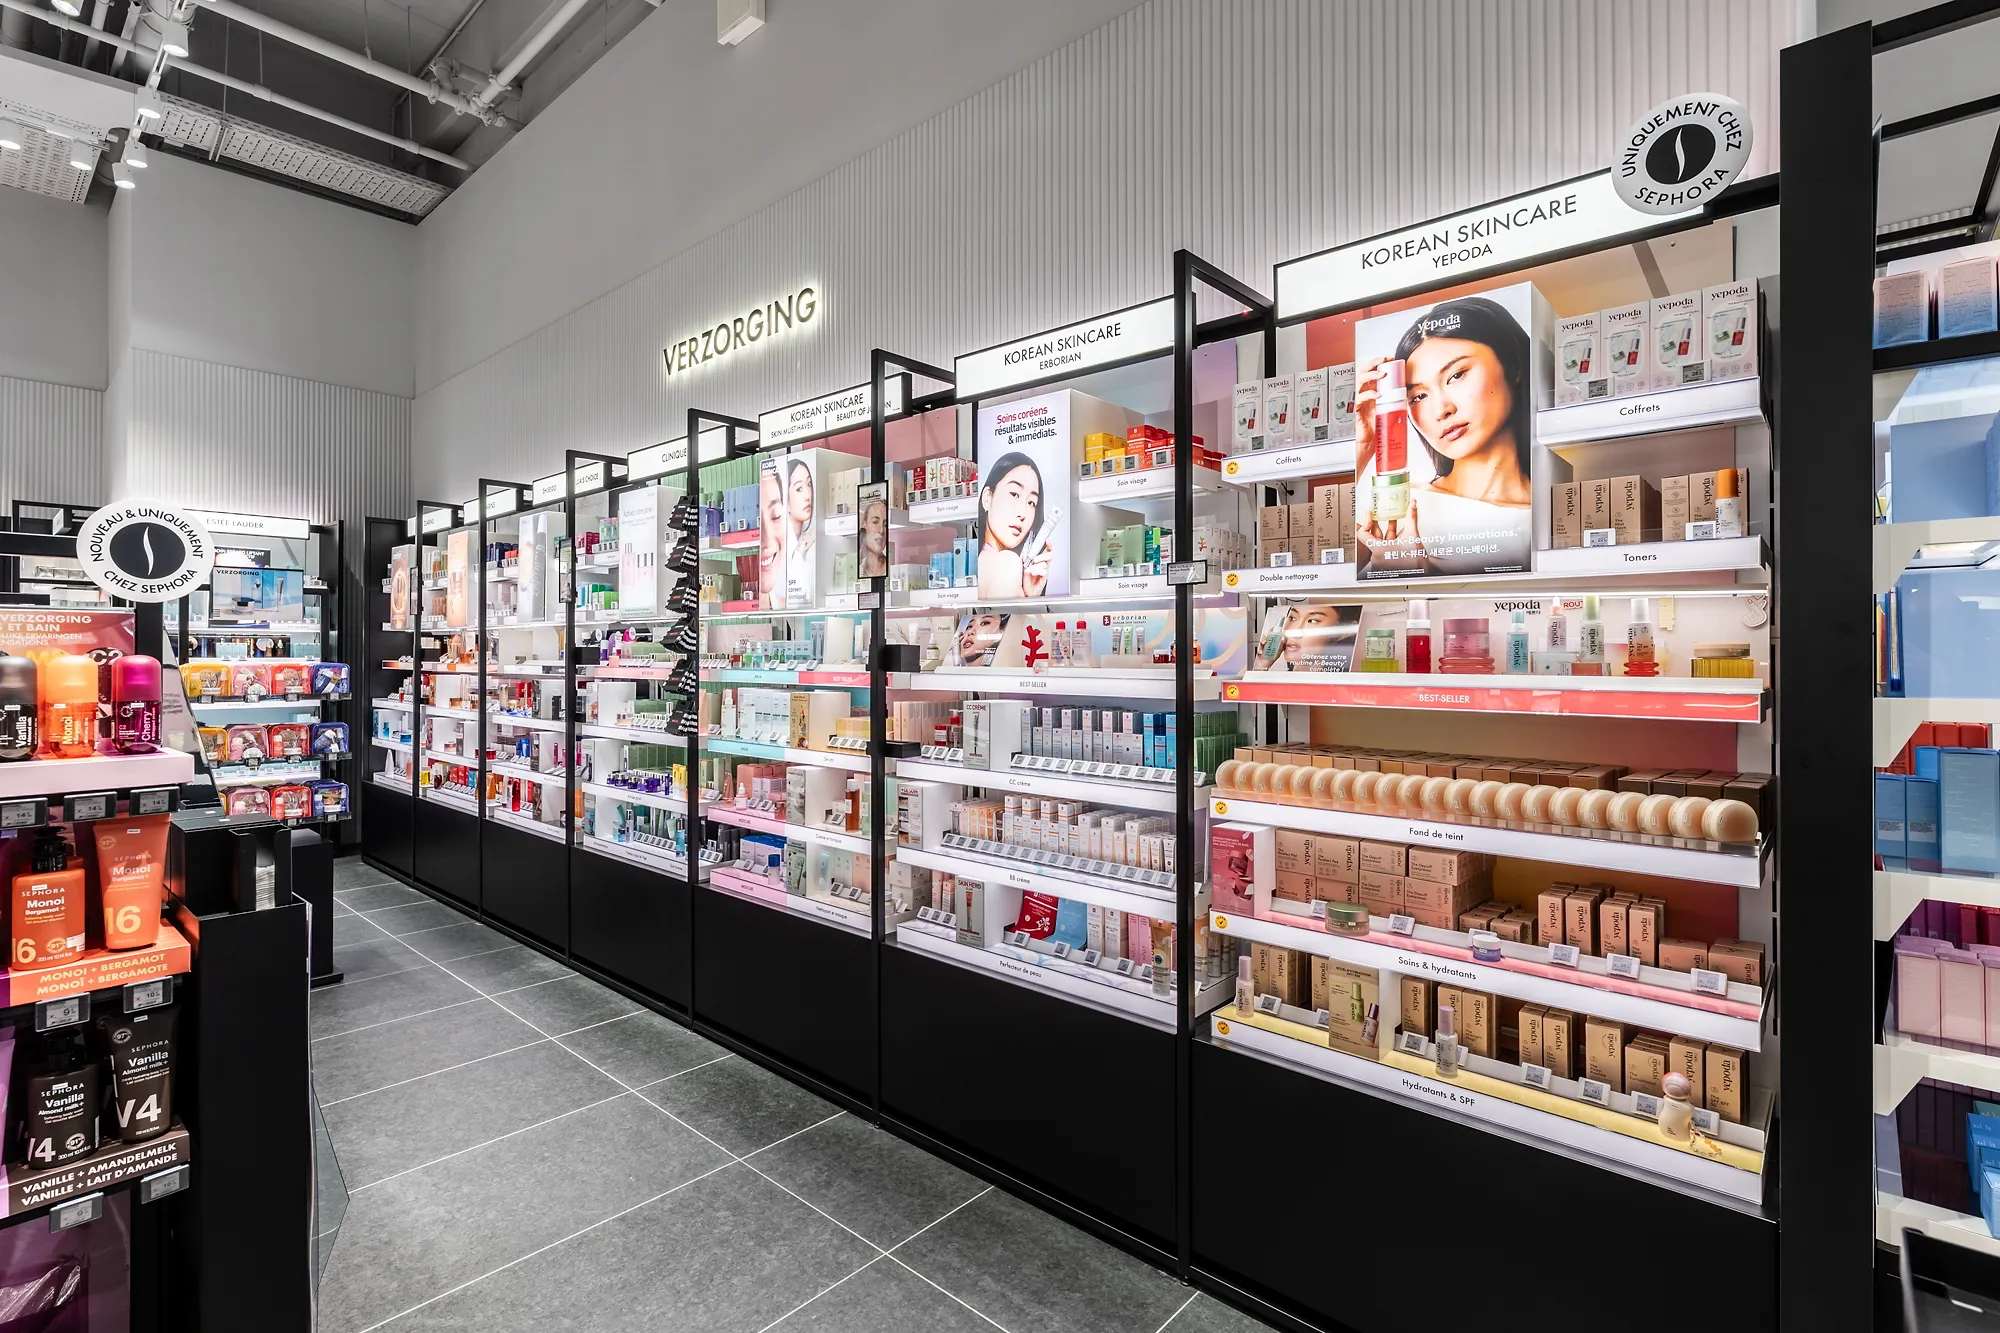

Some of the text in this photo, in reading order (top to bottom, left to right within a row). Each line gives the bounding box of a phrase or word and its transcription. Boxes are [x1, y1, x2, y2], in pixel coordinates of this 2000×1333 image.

[1622, 101, 1742, 178] UNIQUEMENT CHEZ
[1635, 167, 1729, 206] SEPHORA
[1362, 195, 1577, 269] KOREAN SKINCARE
[1432, 244, 1492, 268] YEPODA
[1711, 285, 1748, 300] yepoda
[1658, 298, 1693, 312] yepoda
[1417, 314, 1460, 333] yepoda
[1608, 309, 1642, 322] yepoda
[662, 287, 817, 376] VERZORGING
[1561, 319, 1593, 332] yepoda
[1004, 322, 1121, 366] KOREAN SKINCARE
[1039, 352, 1082, 371] ERBORIAN
[790, 405, 822, 423] KOREAN
[823, 393, 864, 414] SKINCARE
[836, 410, 857, 422] BEAUTY
[857, 407, 866, 416] OF
[996, 406, 1048, 424] Soins coréens
[1620, 404, 1661, 415] Coffrets
[770, 421, 813, 439] SKIN MUST-HAVES
[994, 416, 1057, 436] résultats visibles
[1008, 428, 1057, 444] & immédiats.
[661, 447, 687, 463] CLINIQUE
[1275, 456, 1302, 465] Coffrets
[1129, 477, 1147, 485] visage
[1594, 484, 1604, 514] yepoda
[1625, 481, 1635, 511] yepoda
[1704, 477, 1713, 506] yepoda
[1566, 487, 1575, 517] yepoda
[232, 520, 264, 529] LAUDER
[90, 508, 203, 562] NOUVEAU & UNIQUEMENT
[1366, 538, 1395, 547] Clean
[1397, 534, 1446, 546] K-Beauty
[1429, 547, 1453, 557] 새로운
[1623, 553, 1657, 562] Toners
[104, 568, 198, 594] CHEZ SEPHORA
[1285, 573, 1318, 581] nettoyage
[1494, 600, 1541, 613] yepoda
[8, 624, 60, 632] ET BAIN
[1551, 621, 1559, 647] yepoda
[1419, 694, 1470, 703] BEST-SELLER
[16, 716, 27, 748] Vanilla
[62, 716, 73, 744] Monoi
[142, 711, 152, 742] Cherry
[1409, 828, 1464, 841] Fond de teint
[114, 854, 152, 862] SEPHORA
[112, 864, 152, 876] Monoi
[112, 874, 144, 882] Bergamot
[22, 887, 65, 897] SEPHORA
[25, 907, 60, 915] Bergamot
[27, 897, 65, 909] Monoi
[40, 968, 88, 983] MONOI
[101, 954, 165, 971] BERGAMOT
[1000, 960, 1022, 972] Perfecteur
[1029, 970, 1042, 978] peau
[1398, 957, 1476, 980] Soins & hydratants
[36, 977, 85, 995] MONOÏ
[98, 964, 168, 983] BERGAMOTE
[131, 1040, 169, 1053] SEPHORA
[128, 1052, 169, 1067] Vanilla
[1684, 1051, 1695, 1083] yepoda
[122, 1064, 148, 1076] Almond
[1721, 1060, 1733, 1093] yepoda
[41, 1083, 84, 1097] SEPHORA
[1402, 1079, 1475, 1106] Hydratants & SPF
[45, 1094, 84, 1108] Vanilla
[38, 1107, 63, 1116] Almond
[116, 1094, 161, 1128] V4
[22, 1174, 75, 1194] VANILLE
[88, 1143, 176, 1176] AMANDELMELK
[21, 1187, 74, 1206] VANILLE
[86, 1173, 112, 1188] LAIT
[114, 1153, 178, 1178] D’AMANDE
